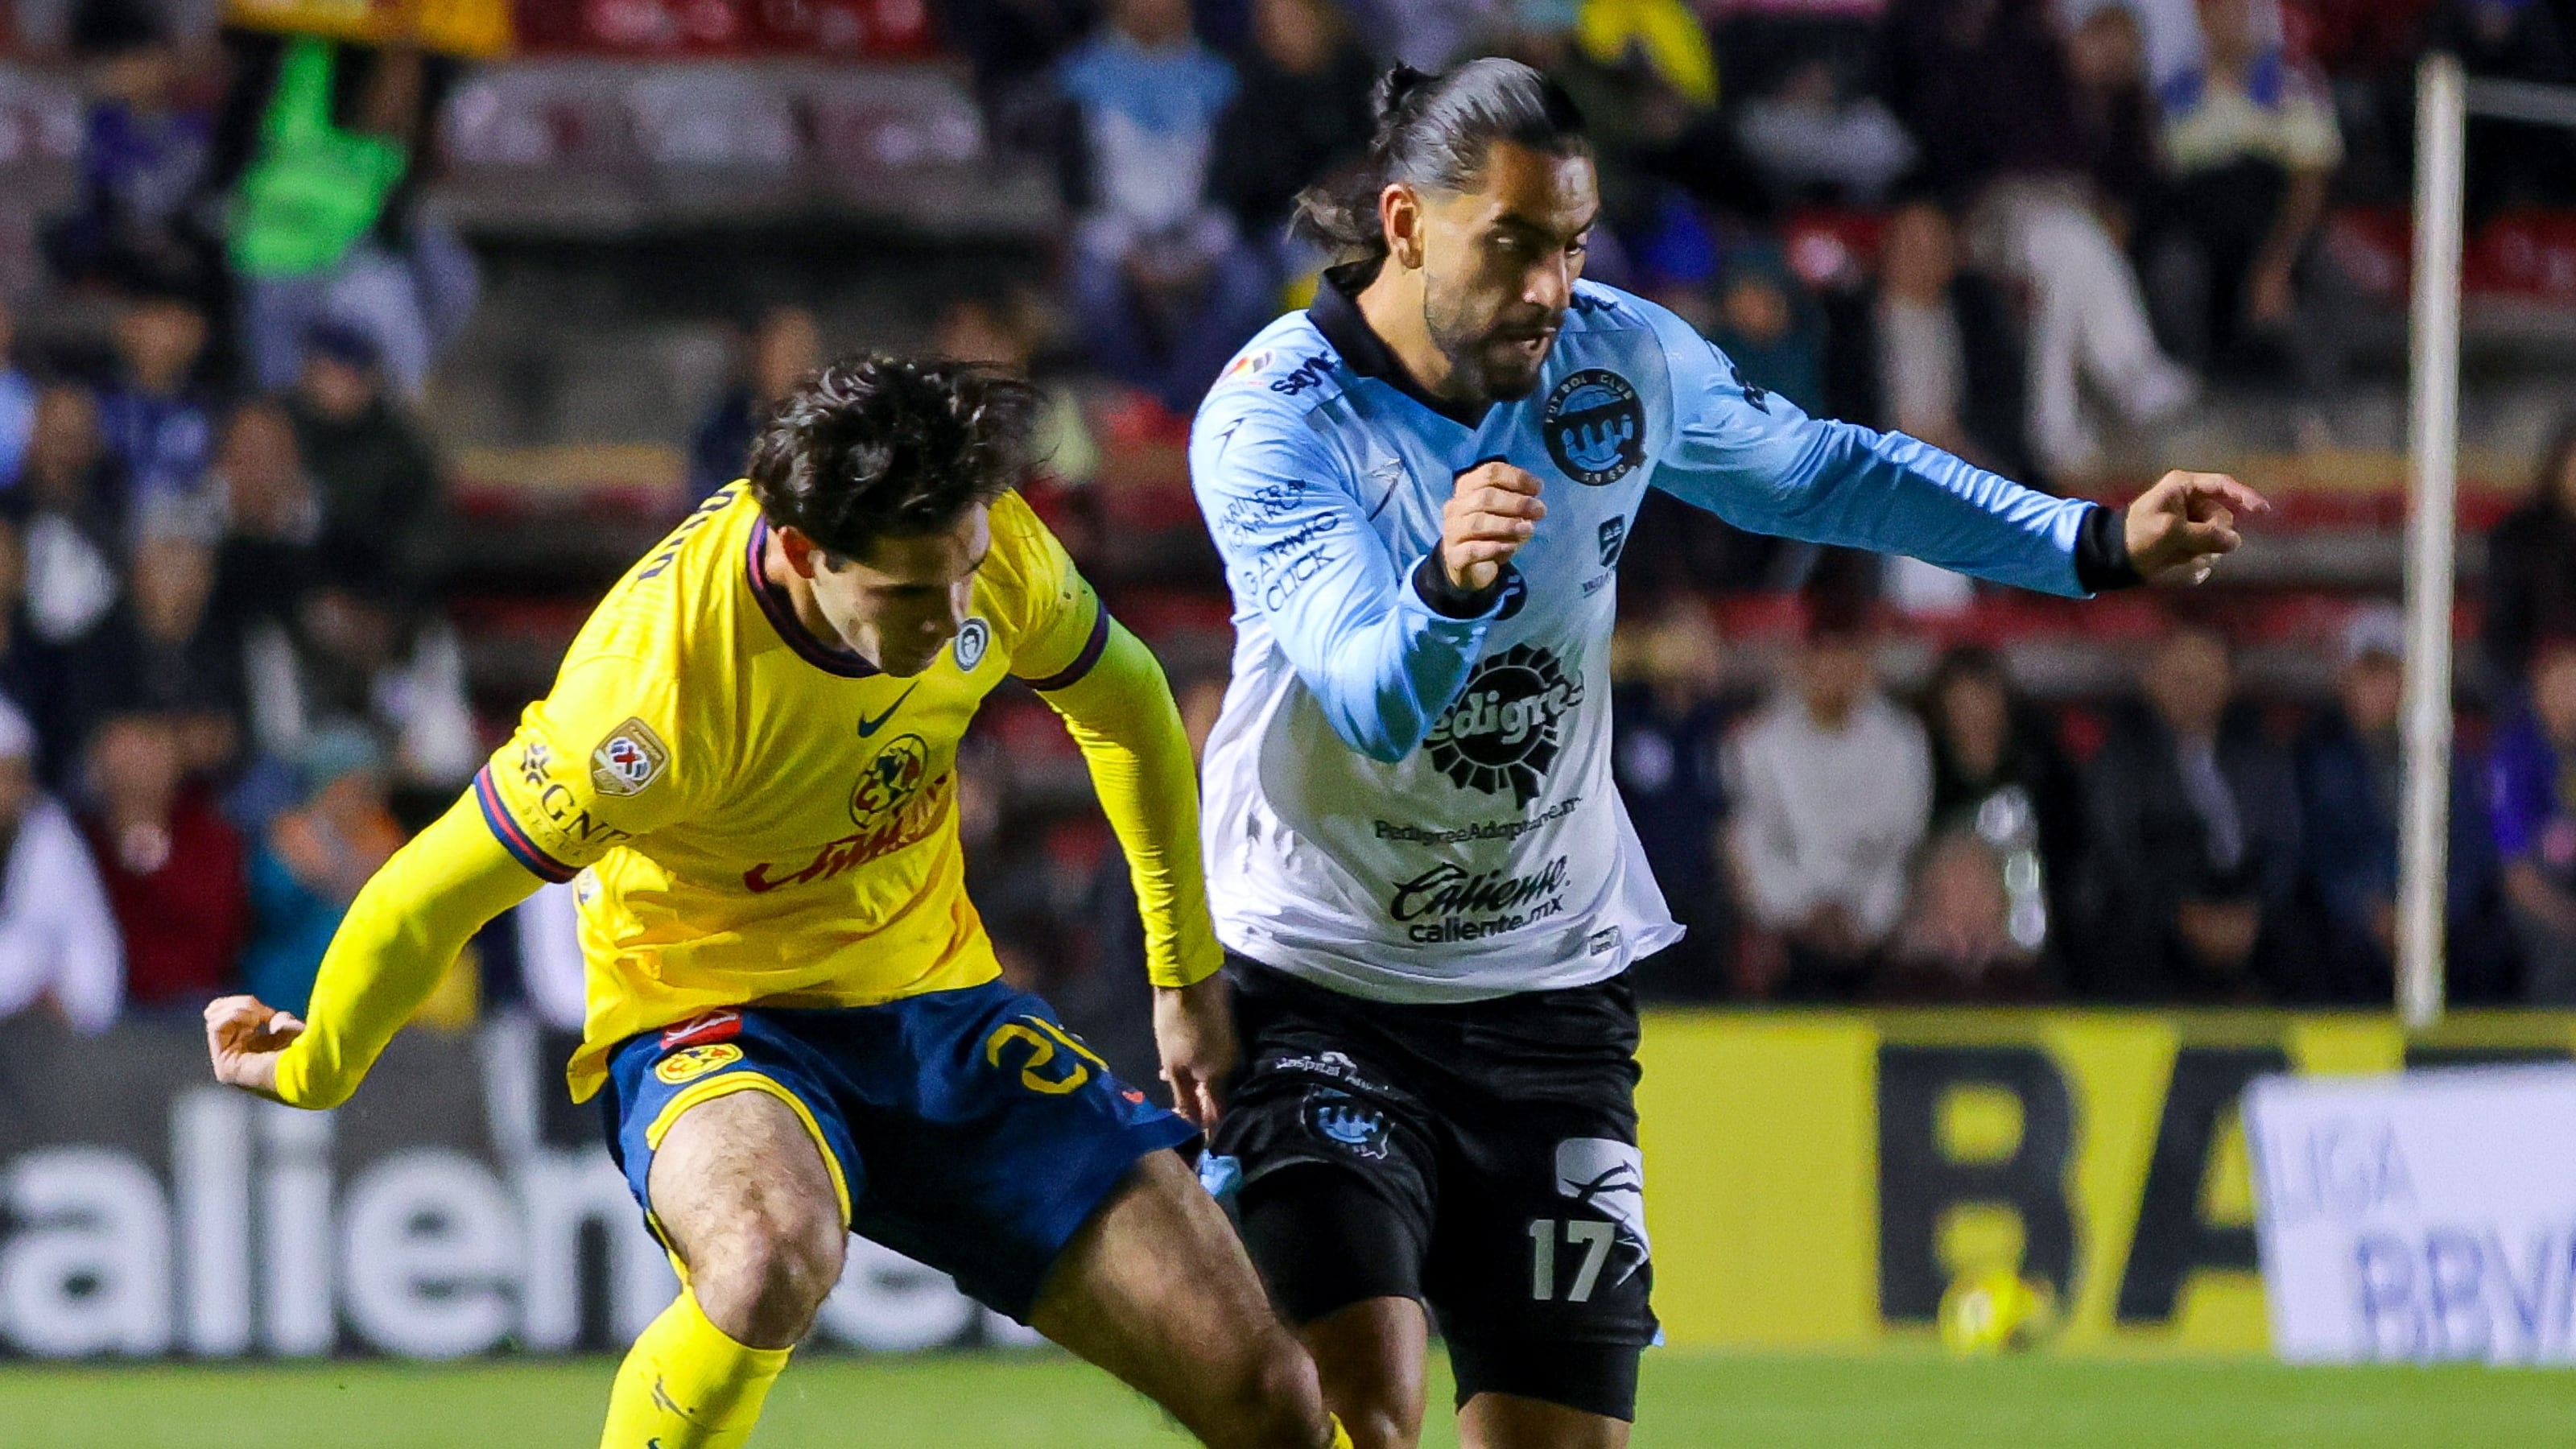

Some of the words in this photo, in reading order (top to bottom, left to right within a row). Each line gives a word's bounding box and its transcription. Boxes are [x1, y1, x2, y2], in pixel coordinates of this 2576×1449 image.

[1600, 374, 1633, 401] CLUB
[1266, 543, 1336, 613] CLICK
[1409, 894, 1564, 943] caliente.mx
[986, 1015, 1110, 1094] 2
[1528, 1218, 1616, 1302] 17
[2351, 1224, 2576, 1365] BBV
